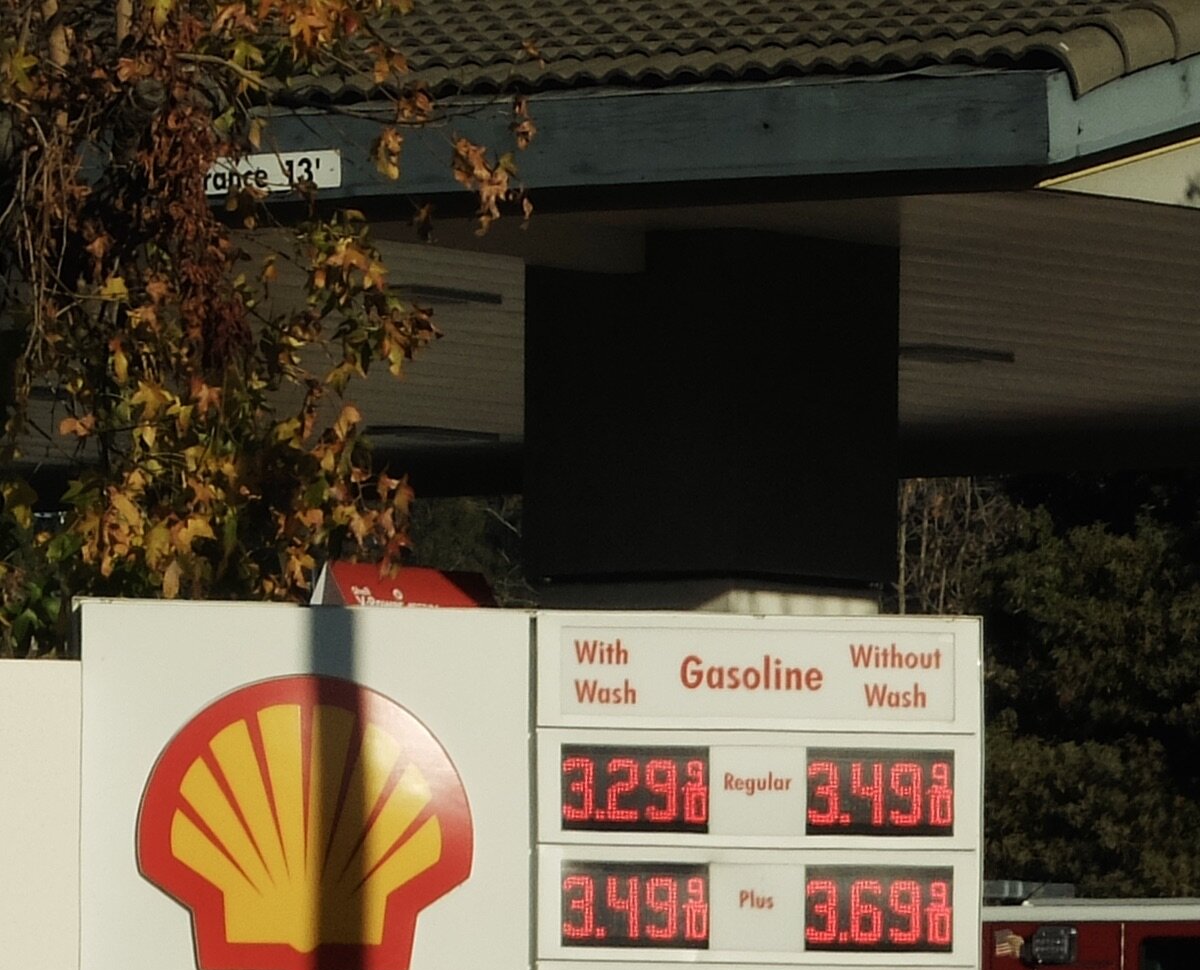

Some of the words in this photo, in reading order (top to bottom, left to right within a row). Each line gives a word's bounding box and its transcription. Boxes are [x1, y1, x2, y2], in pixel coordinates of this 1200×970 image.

[574, 639, 629, 665] With
[849, 643, 942, 670] Without
[680, 655, 823, 691] Gasoline
[574, 679, 637, 705] Wash
[864, 682, 927, 709] Wash
[724, 771, 792, 796] Regular
[739, 889, 775, 910] Plus
